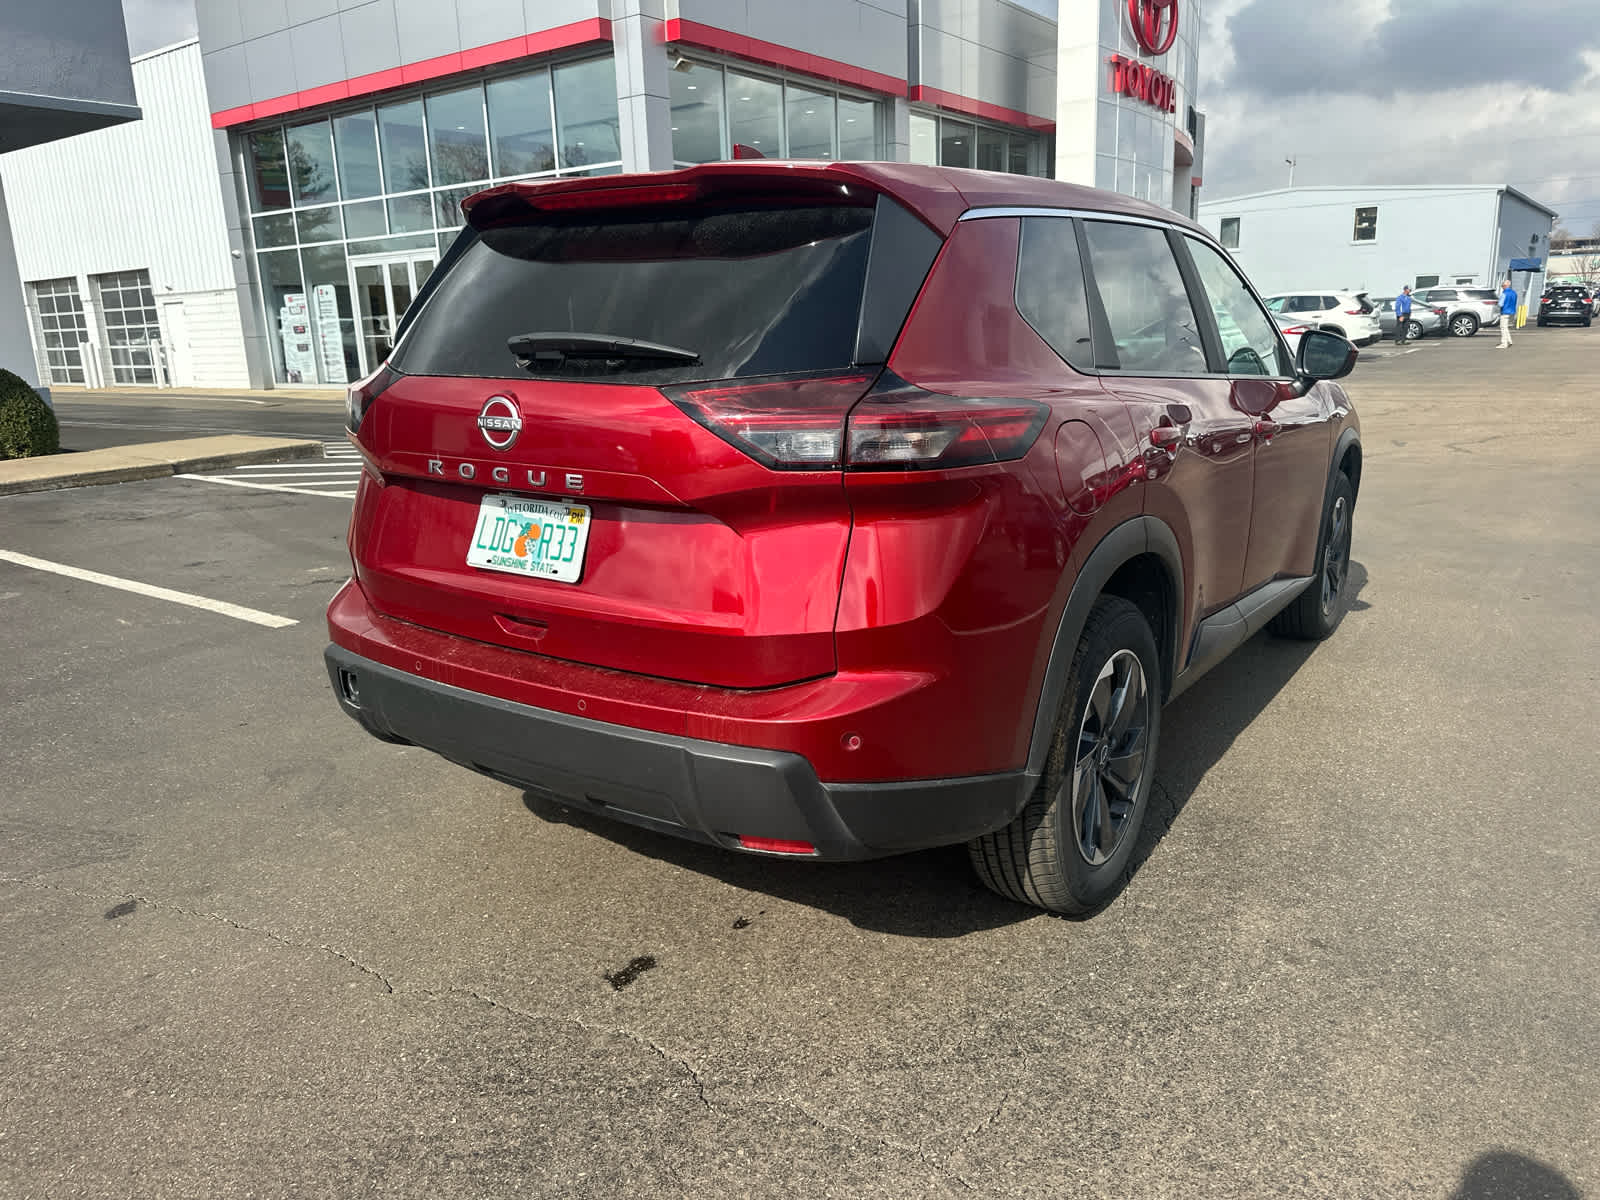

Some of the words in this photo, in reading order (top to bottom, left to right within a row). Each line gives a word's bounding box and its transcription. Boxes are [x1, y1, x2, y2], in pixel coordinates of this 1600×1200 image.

[1111, 54, 1176, 113] TOYOTA
[478, 417, 522, 430] NISSAN
[428, 459, 584, 490] ROGUE
[476, 515, 518, 553] LDG
[537, 523, 579, 563] A33
[491, 555, 529, 570] SUNSHINE
[530, 560, 555, 574] STATE
